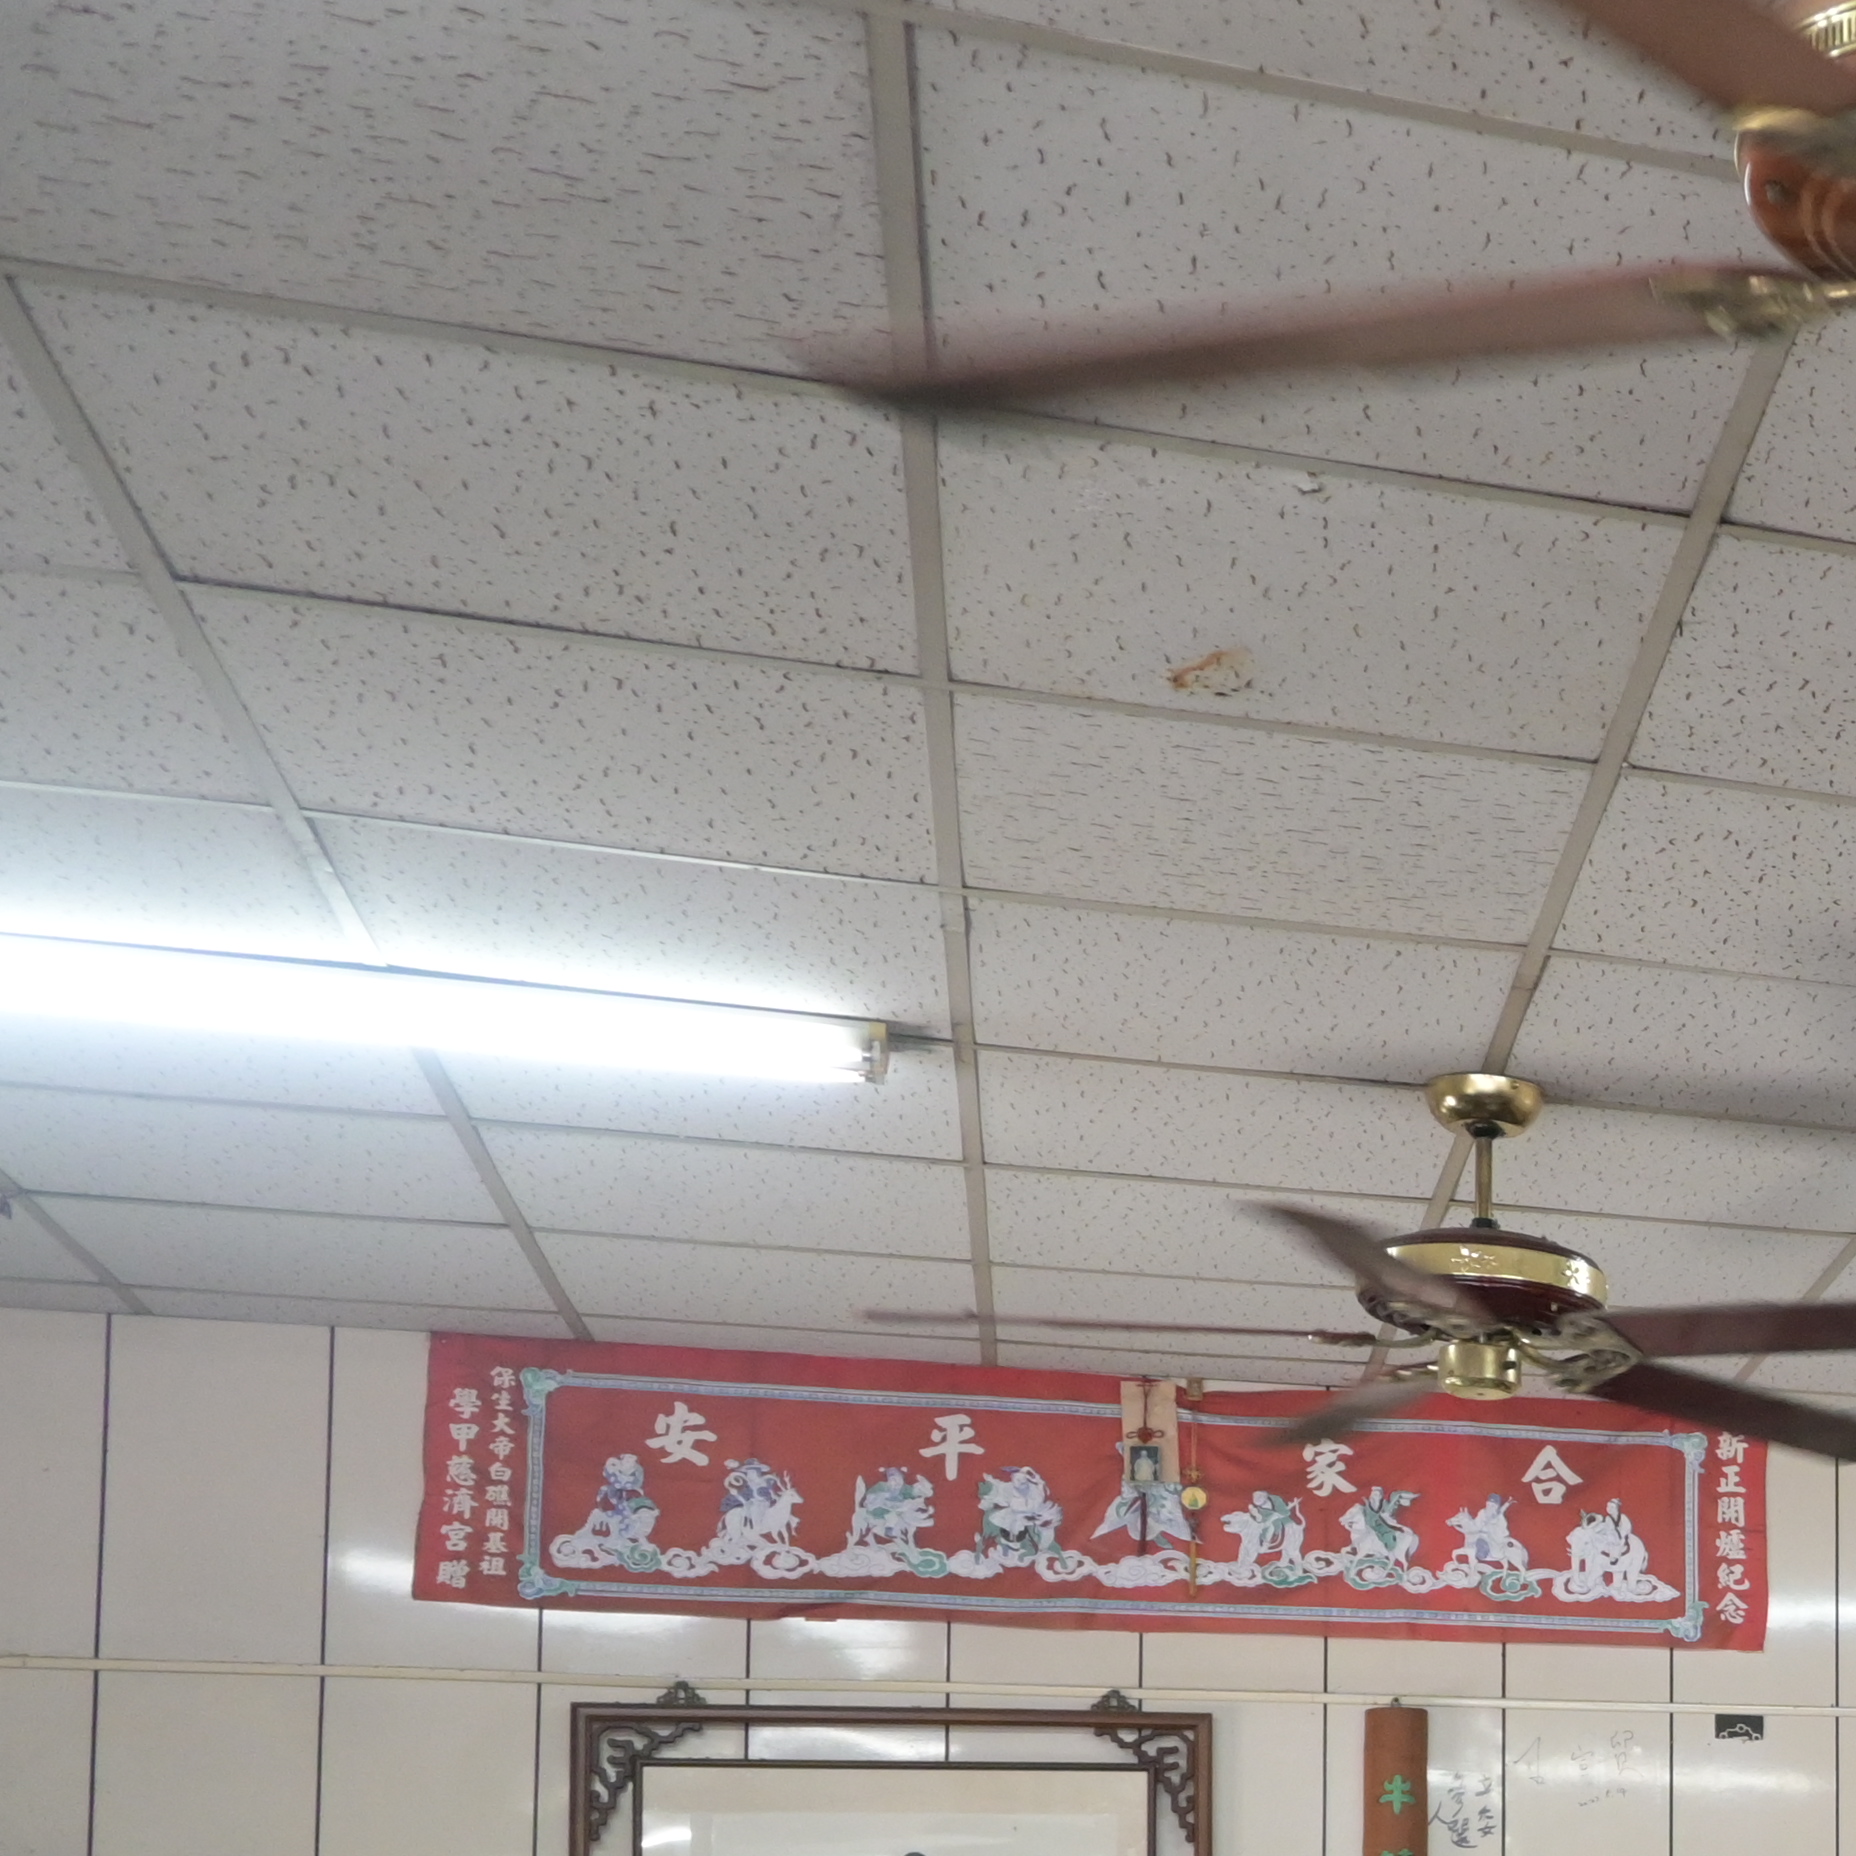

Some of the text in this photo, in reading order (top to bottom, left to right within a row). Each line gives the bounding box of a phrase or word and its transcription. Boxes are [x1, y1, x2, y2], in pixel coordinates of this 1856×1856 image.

[436, 1388, 482, 1590] 學甲慈濟宮贈
[1715, 1431, 1750, 1625] 新正開爐紀念
